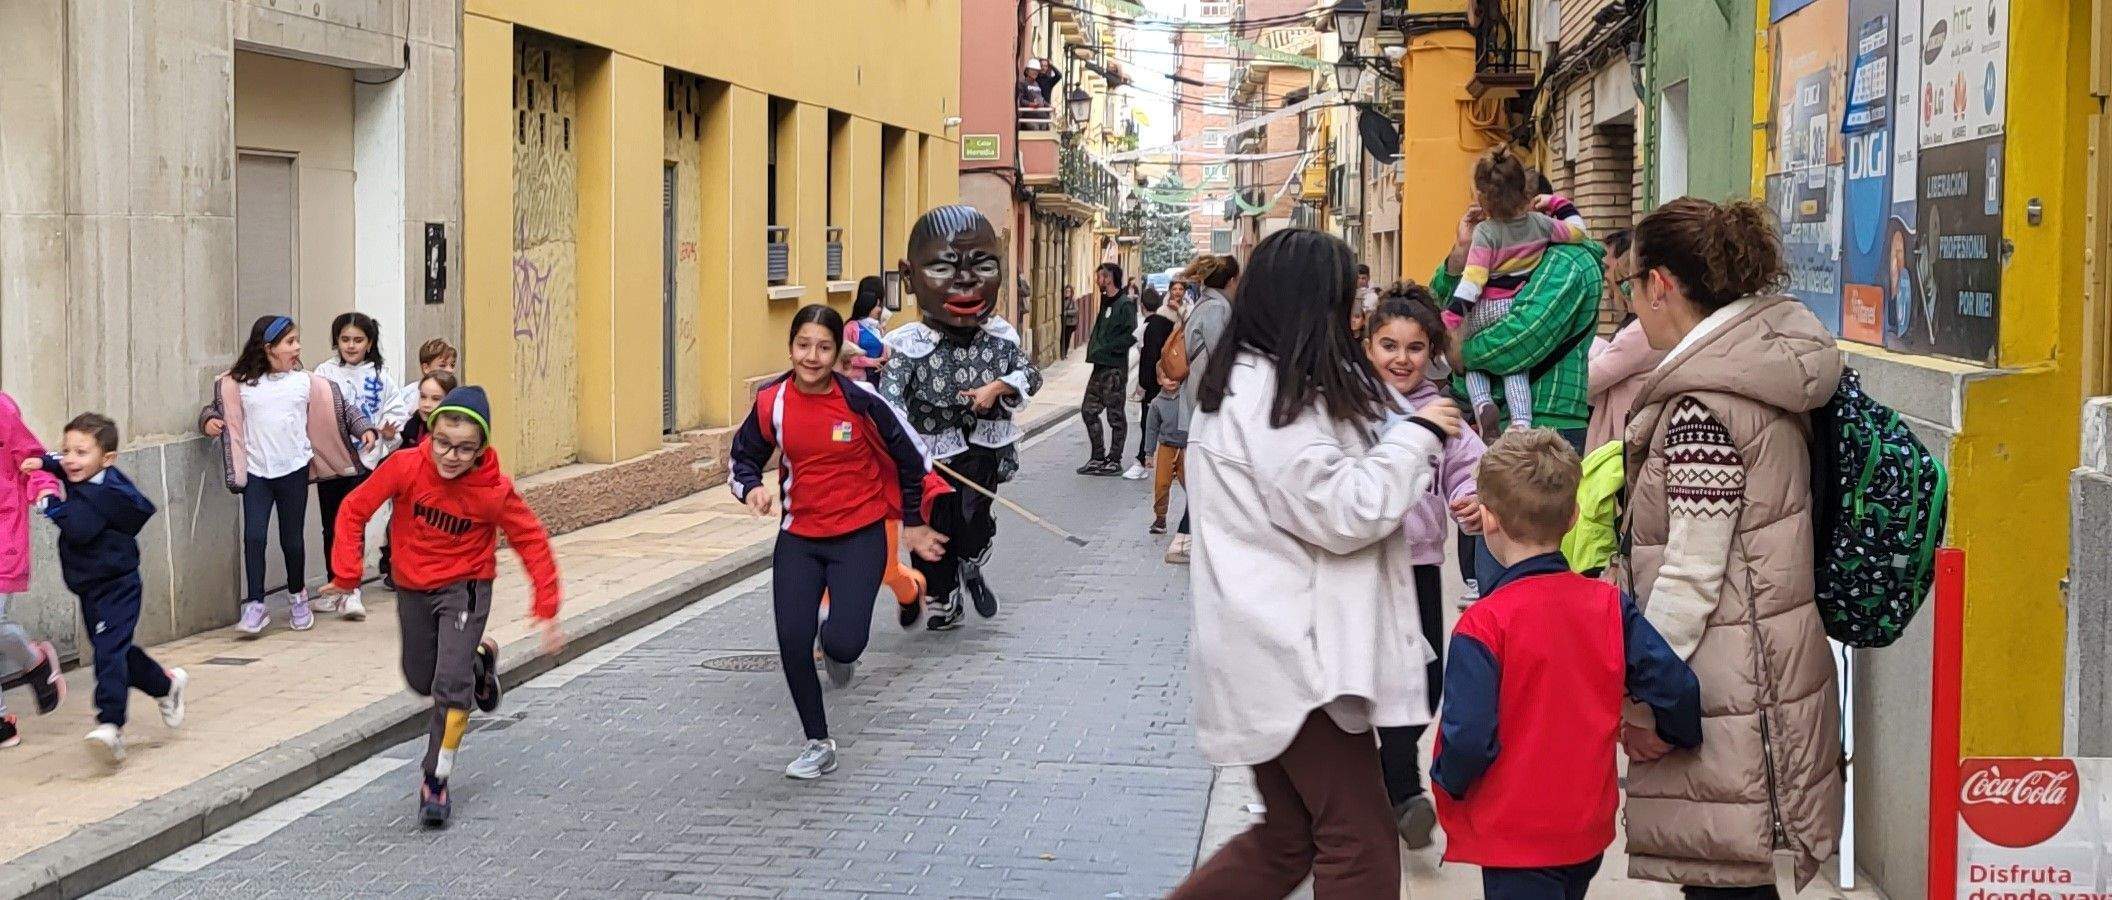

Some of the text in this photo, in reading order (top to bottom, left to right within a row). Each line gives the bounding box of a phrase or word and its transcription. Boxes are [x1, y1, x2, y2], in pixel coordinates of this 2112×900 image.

[1849, 130, 1888, 180] DIGI
[1939, 233, 1989, 260] PROFESIONAL
[1958, 291, 1975, 317] POR
[413, 501, 472, 536] PUMA
[1969, 864, 2072, 883] Disfruta
